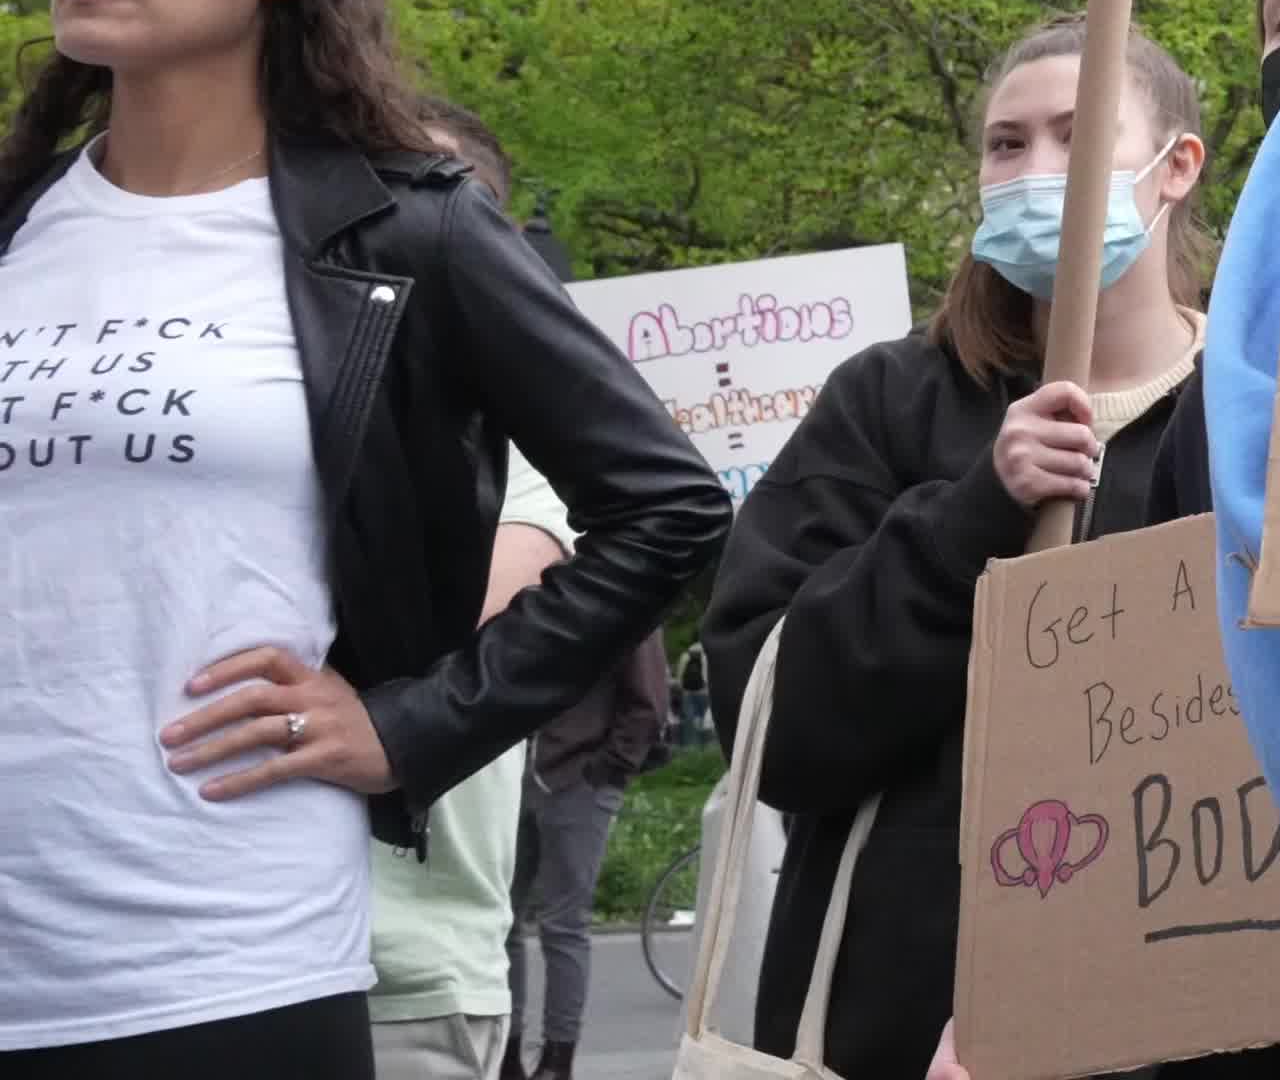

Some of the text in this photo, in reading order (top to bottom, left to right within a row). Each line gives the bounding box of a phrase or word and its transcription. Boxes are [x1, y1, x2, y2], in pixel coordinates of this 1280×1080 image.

[628, 294, 853, 362] Abortions
[0, 351, 156, 383] TH US
[124, 433, 195, 463] US
[1025, 559, 1196, 668] Get A
